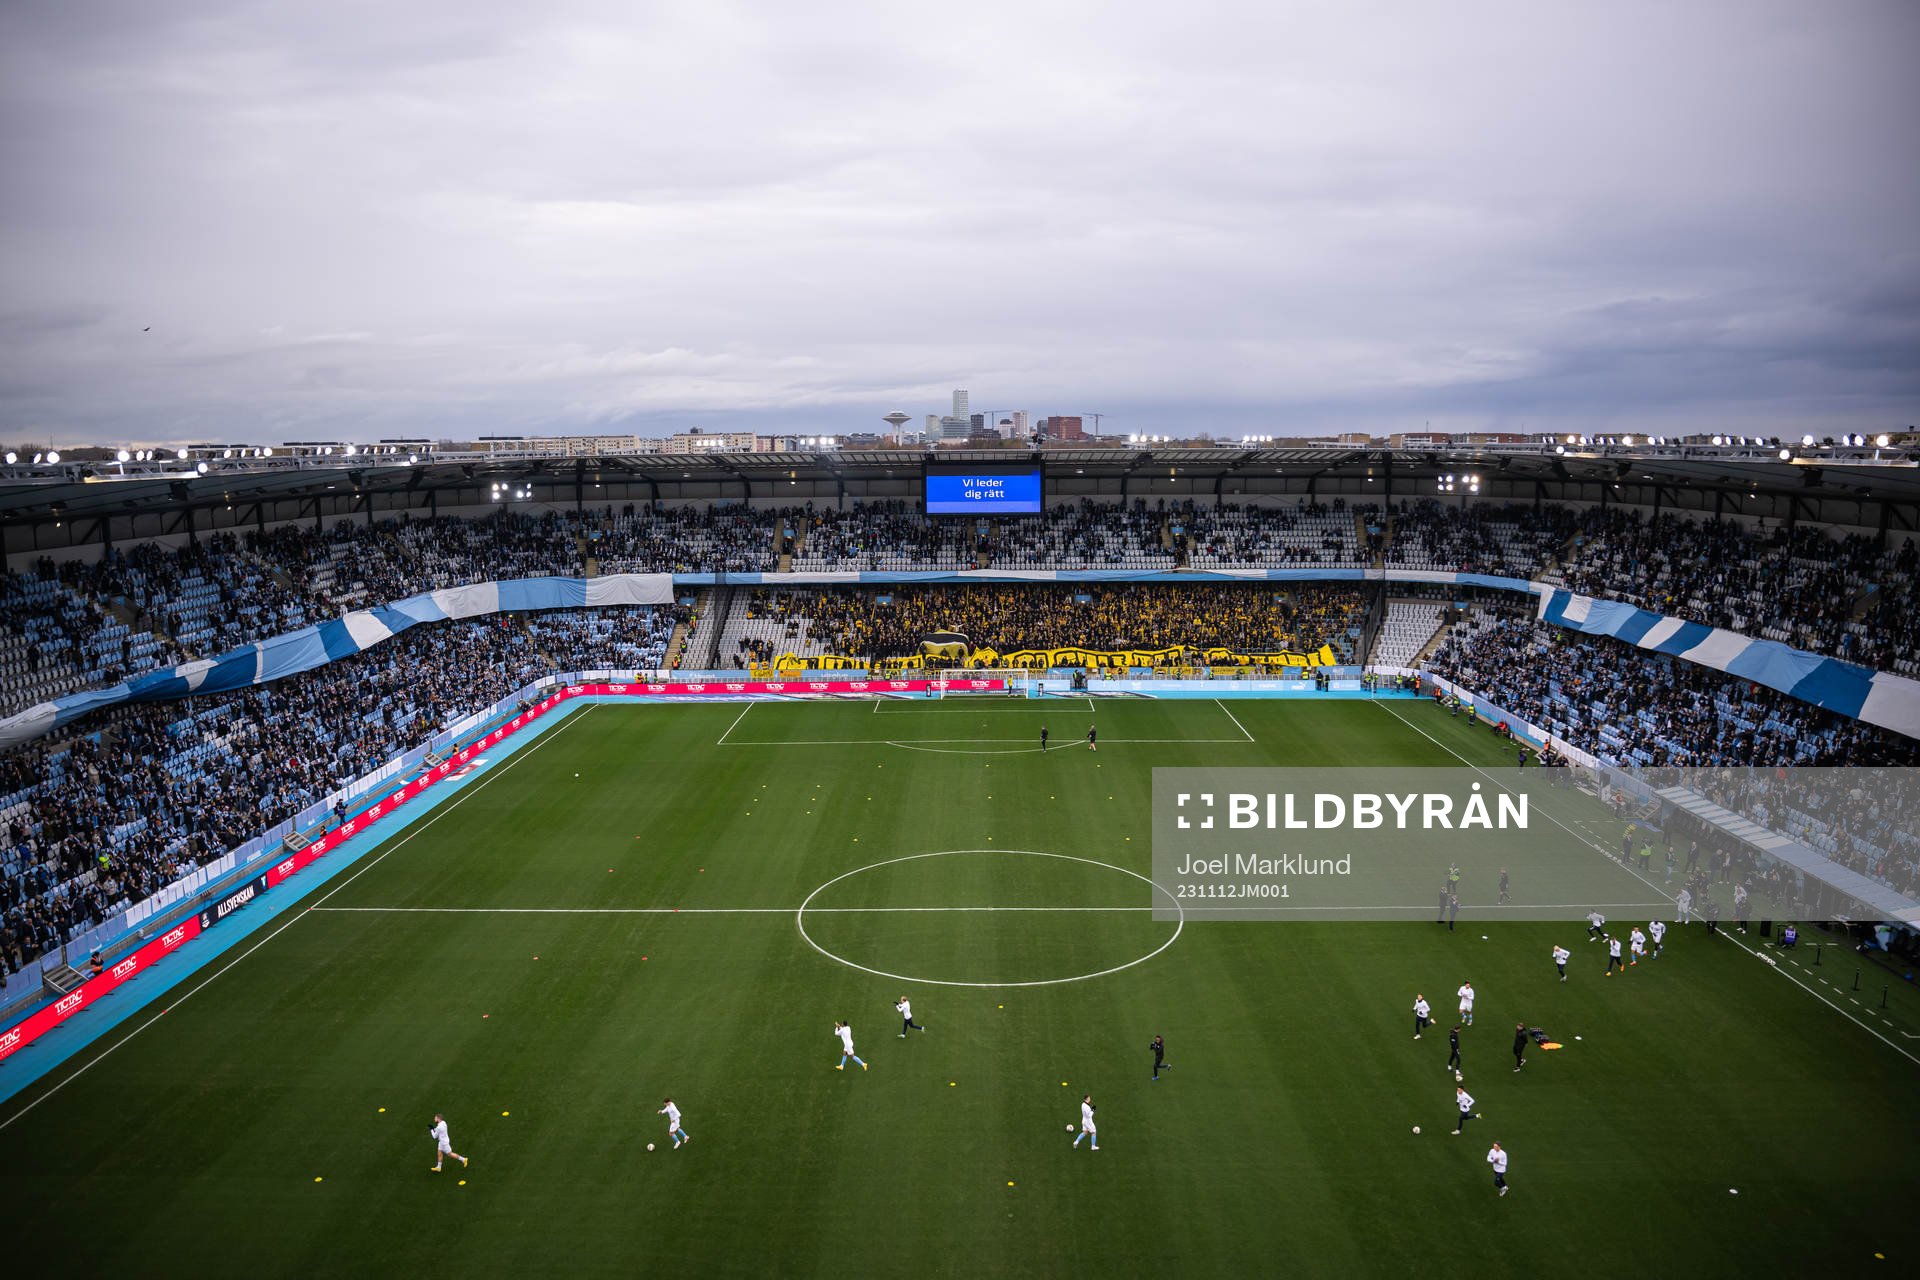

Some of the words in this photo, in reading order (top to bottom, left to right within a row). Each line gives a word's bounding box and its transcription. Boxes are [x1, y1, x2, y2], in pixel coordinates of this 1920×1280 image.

[963, 479, 973, 487] Vi
[976, 478, 1003, 487] leder
[965, 489, 981, 499] dig
[984, 489, 1004, 498] rätt
[217, 885, 255, 918] ALLSVENSKAN
[162, 926, 185, 946] TICTAC
[112, 956, 137, 977] TICTAC
[54, 989, 83, 1013] TICTAC
[0, 1028, 20, 1049] CTAC
